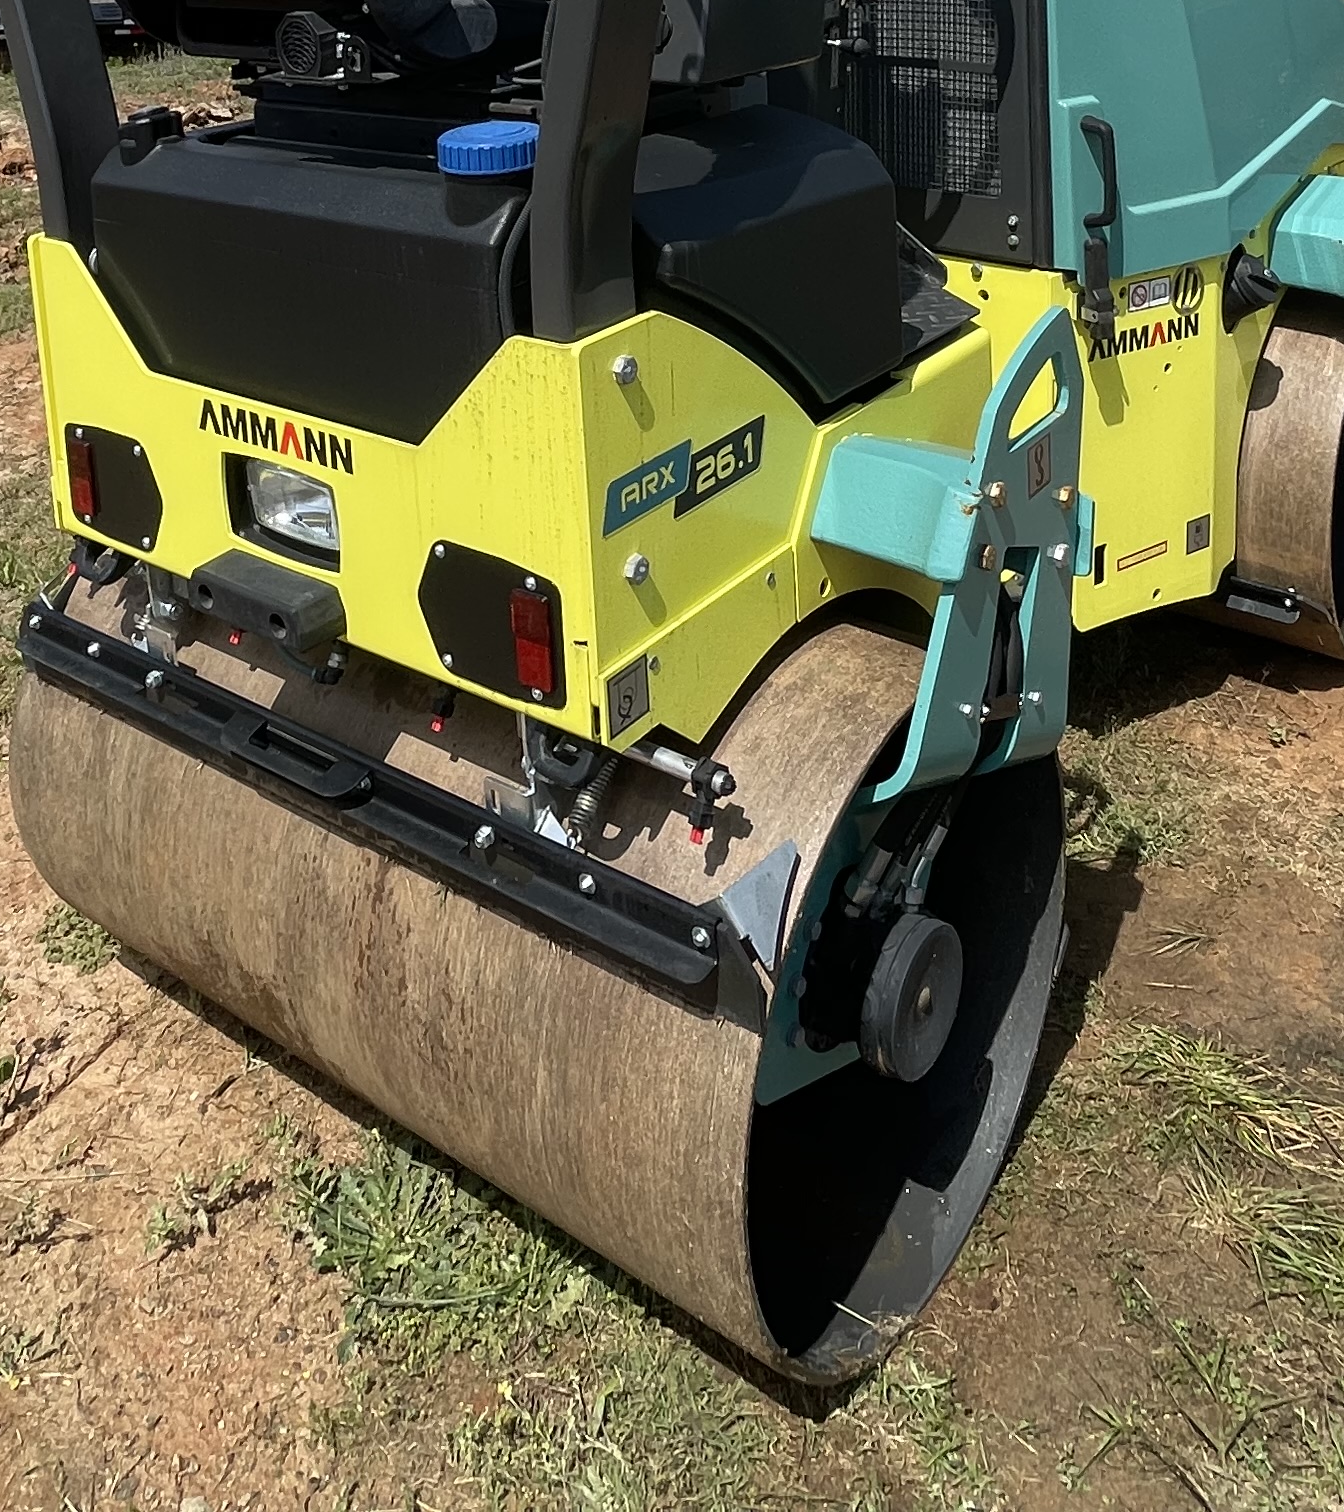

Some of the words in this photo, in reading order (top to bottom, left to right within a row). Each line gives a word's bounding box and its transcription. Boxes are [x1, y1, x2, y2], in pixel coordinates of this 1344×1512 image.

[1087, 313, 1200, 363] AMMANN
[199, 398, 354, 475] AMMANN
[621, 461, 676, 512] ARX
[695, 432, 754, 495] 26.1
